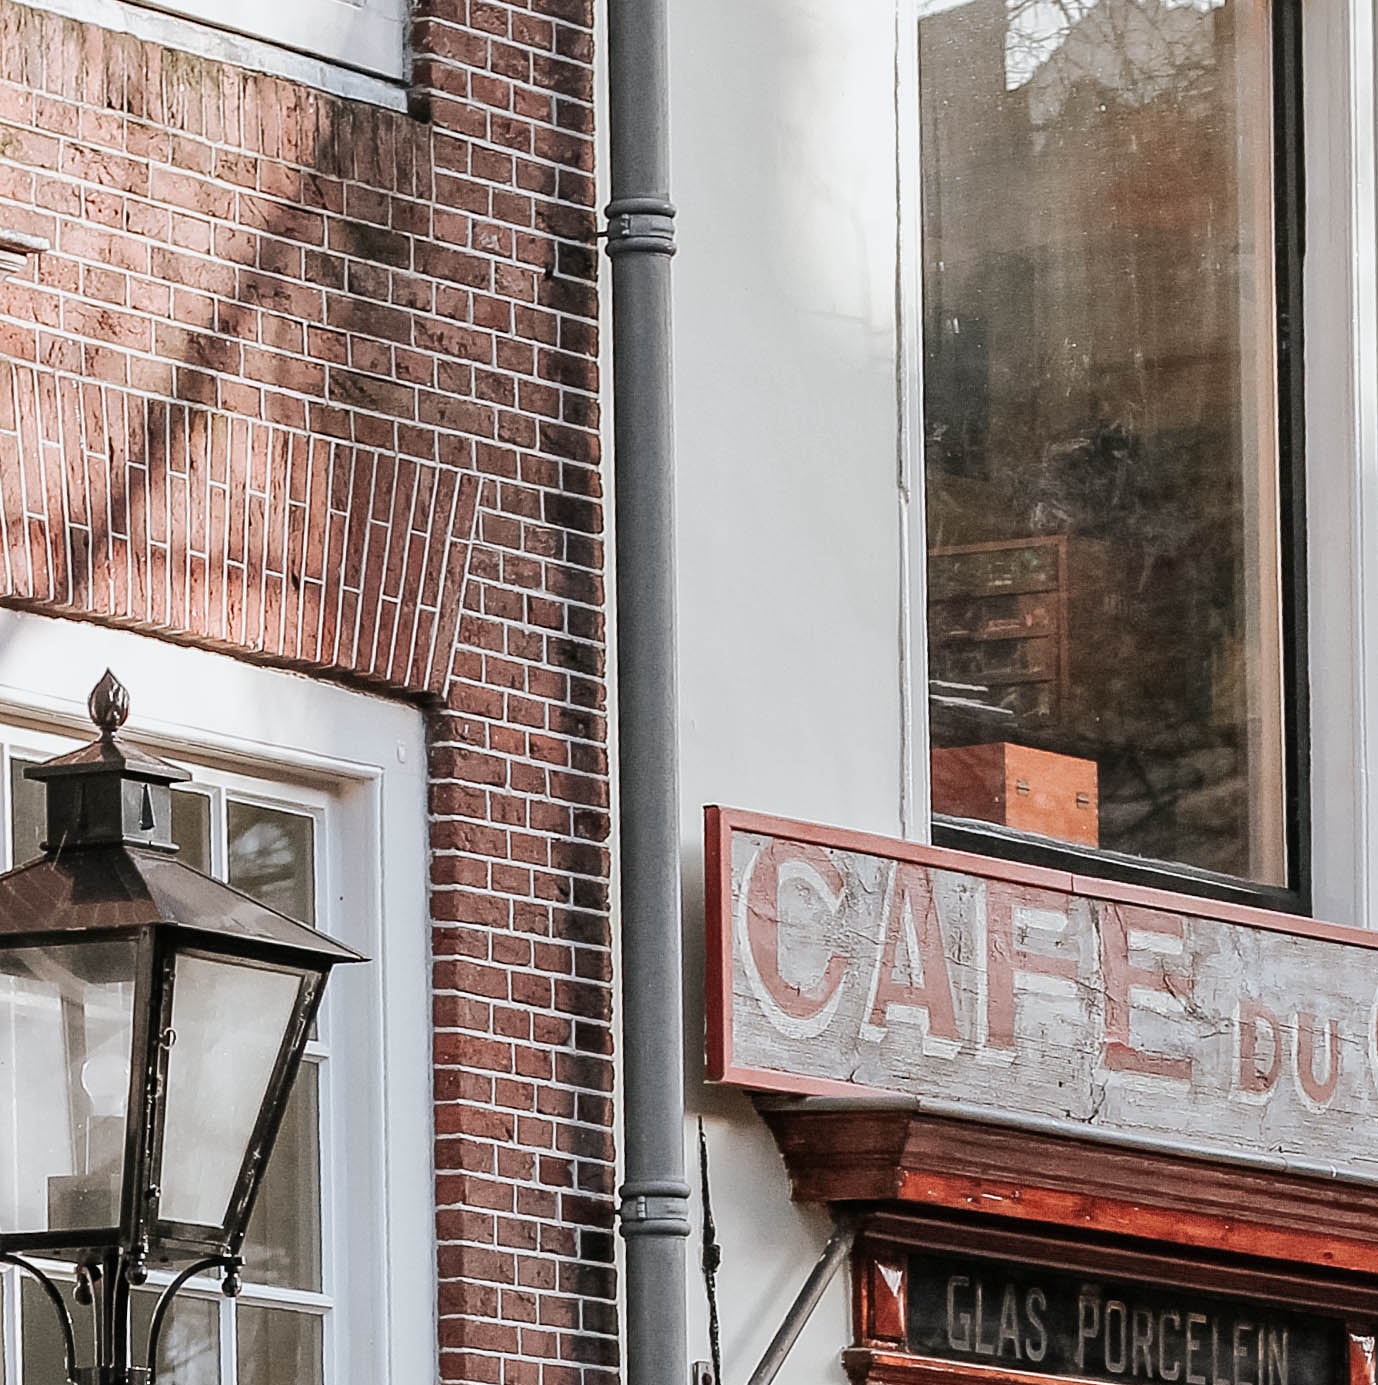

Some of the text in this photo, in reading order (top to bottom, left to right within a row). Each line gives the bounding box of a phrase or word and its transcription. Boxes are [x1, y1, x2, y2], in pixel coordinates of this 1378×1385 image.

[738, 840, 1197, 1083] CAFE
[1232, 992, 1342, 1112] DU
[945, 1274, 1049, 1362] GLAS
